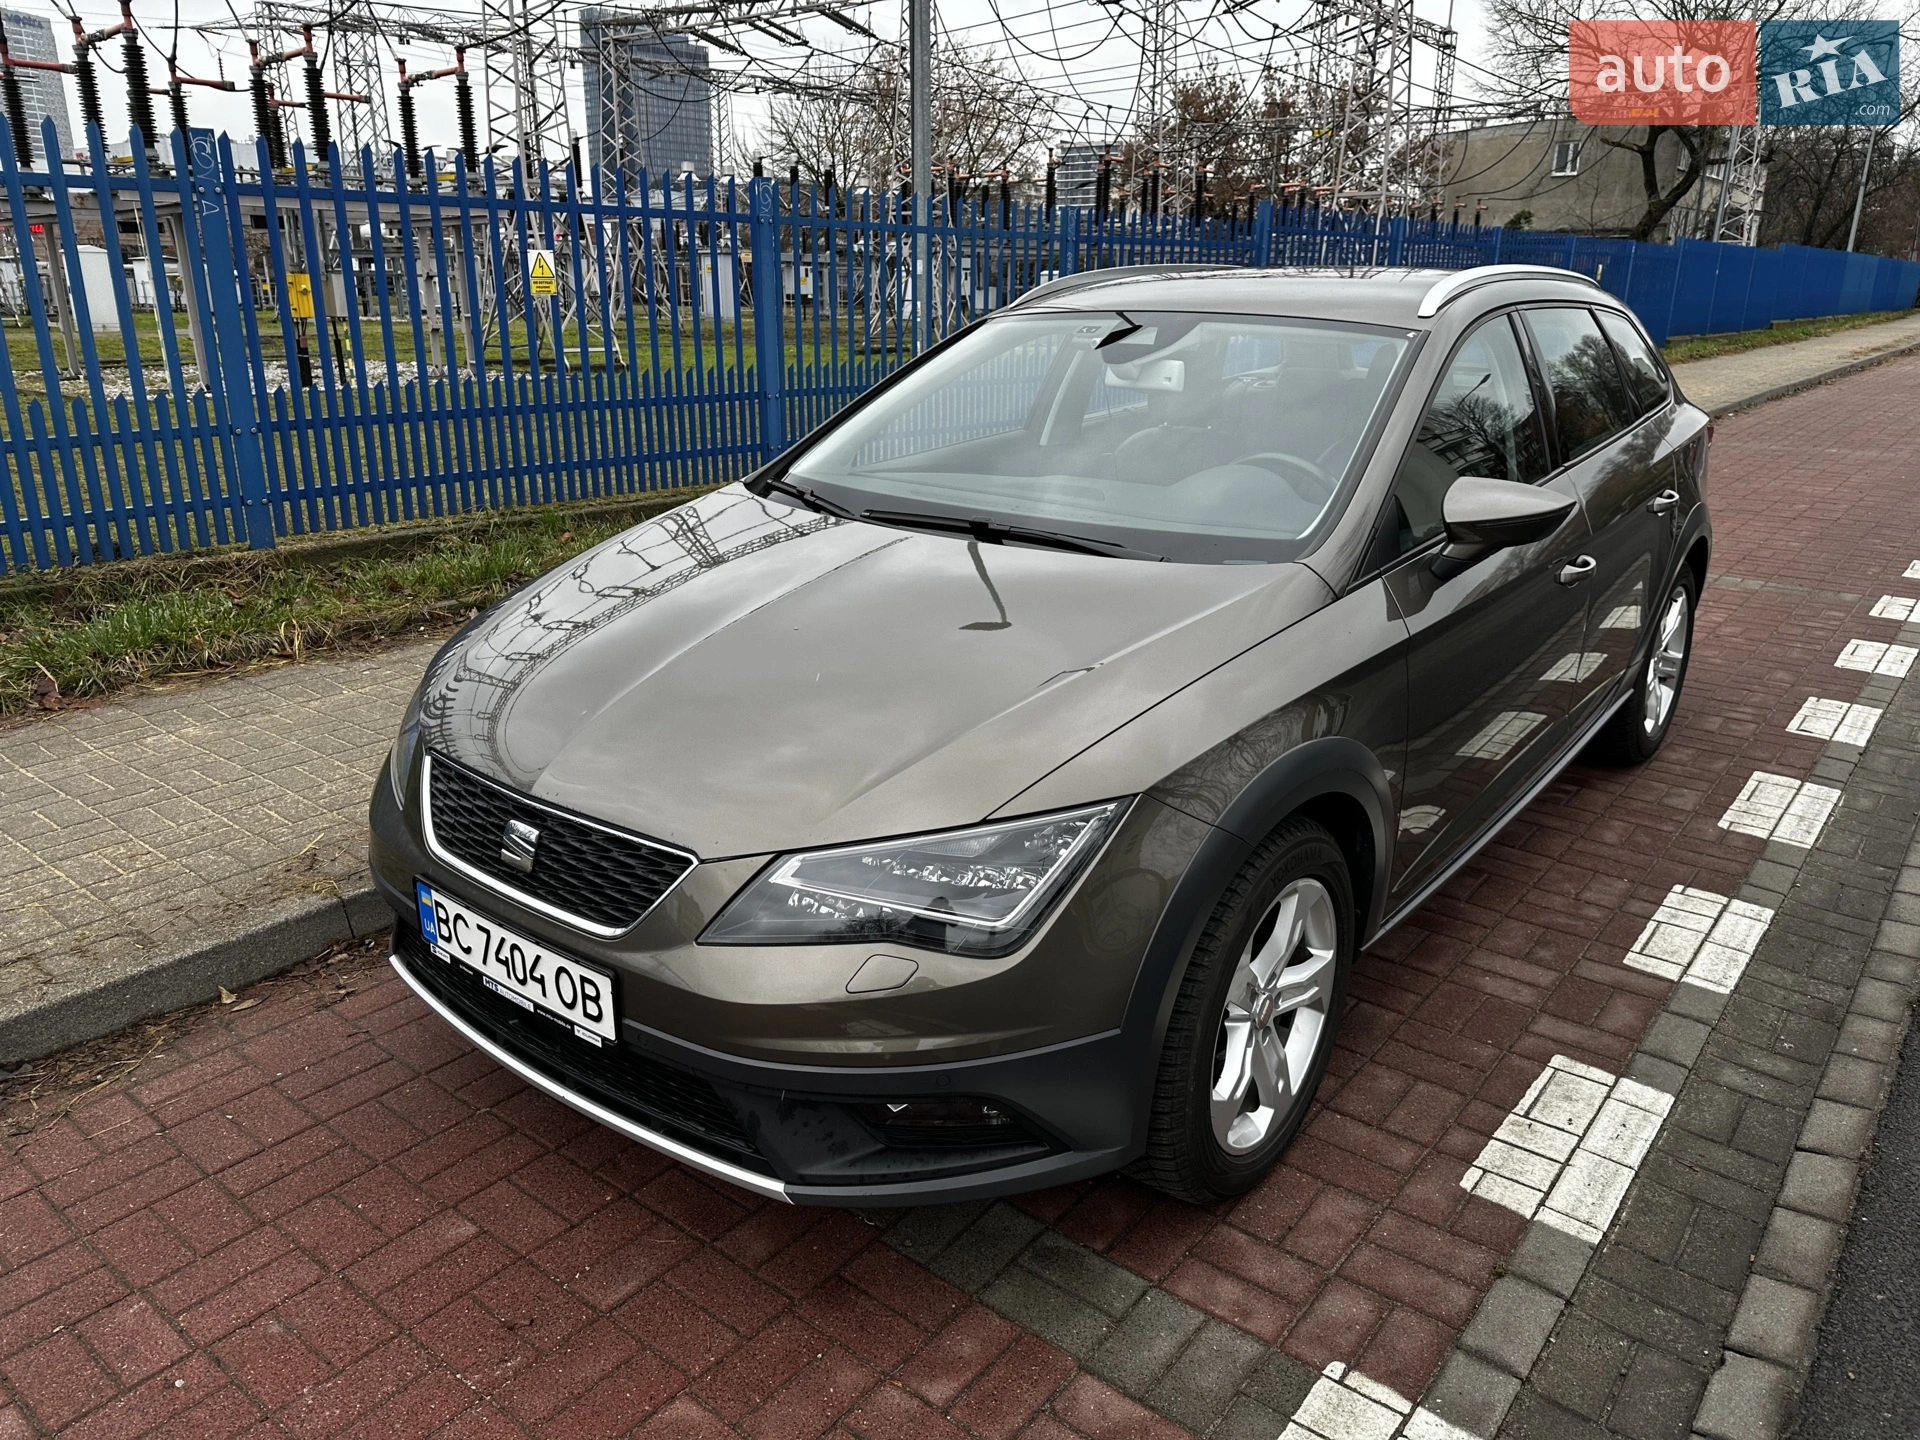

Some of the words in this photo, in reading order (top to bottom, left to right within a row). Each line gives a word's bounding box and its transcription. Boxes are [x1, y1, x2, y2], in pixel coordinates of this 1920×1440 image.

[1269, 846, 1323, 889] YOKOHAMA
[424, 918, 436, 935] UA
[433, 898, 473, 955] BC
[476, 923, 548, 999] 7404
[554, 965, 604, 1024] OB
[484, 977, 500, 992] MTS
[499, 986, 533, 1011] AUTOMOBILE
